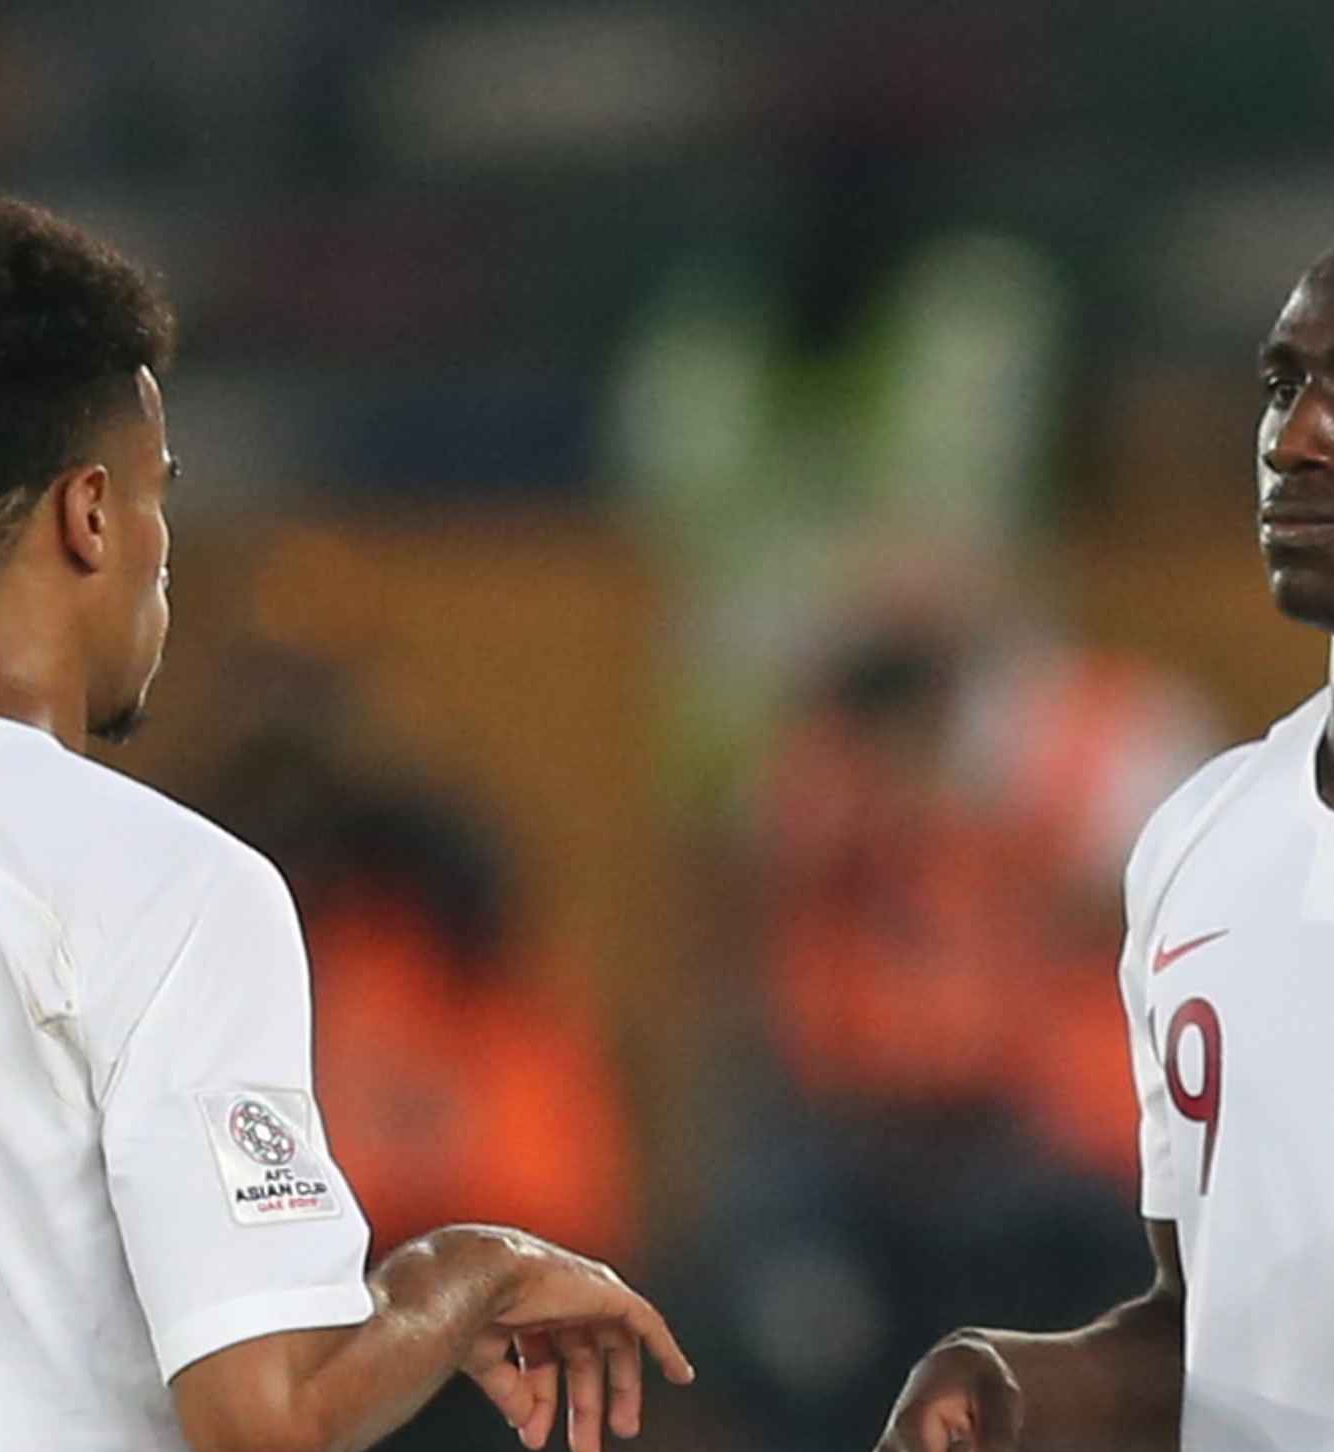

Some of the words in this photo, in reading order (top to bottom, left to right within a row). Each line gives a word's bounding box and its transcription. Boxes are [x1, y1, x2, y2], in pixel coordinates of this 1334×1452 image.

[265, 1168, 294, 1181] AFC
[236, 1183, 292, 1202] ASIAN
[295, 1181, 327, 1195] CUP
